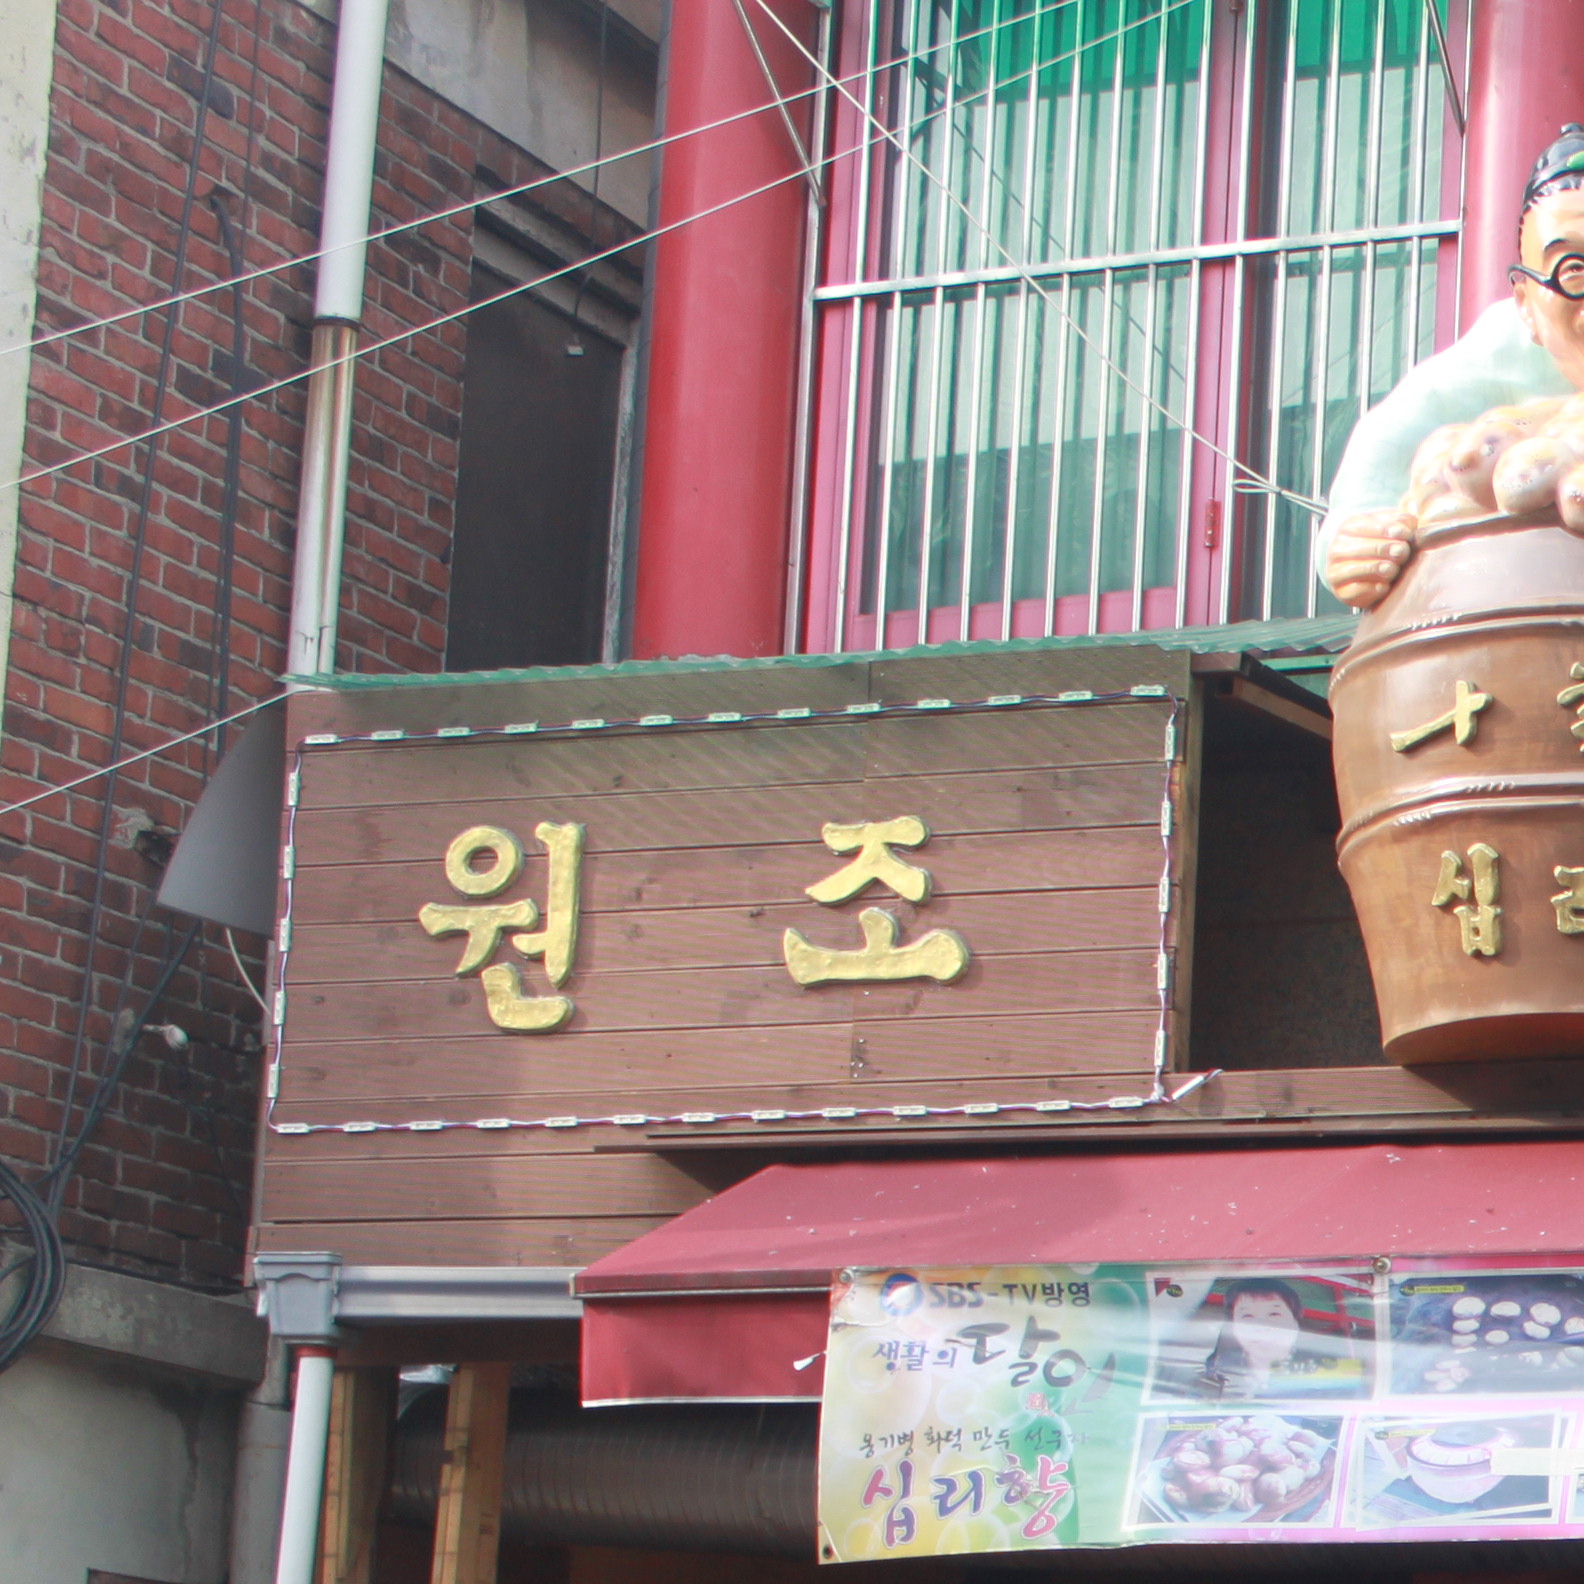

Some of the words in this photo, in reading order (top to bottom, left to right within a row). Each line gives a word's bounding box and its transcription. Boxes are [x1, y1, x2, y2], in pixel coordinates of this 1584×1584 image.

[418, 820, 972, 1034] 원조
[872, 1340, 957, 1373] 생활의
[924, 1426, 963, 1455] 화덕
[973, 1427, 1011, 1451] 만두
[861, 1454, 1073, 1550] 십리향
